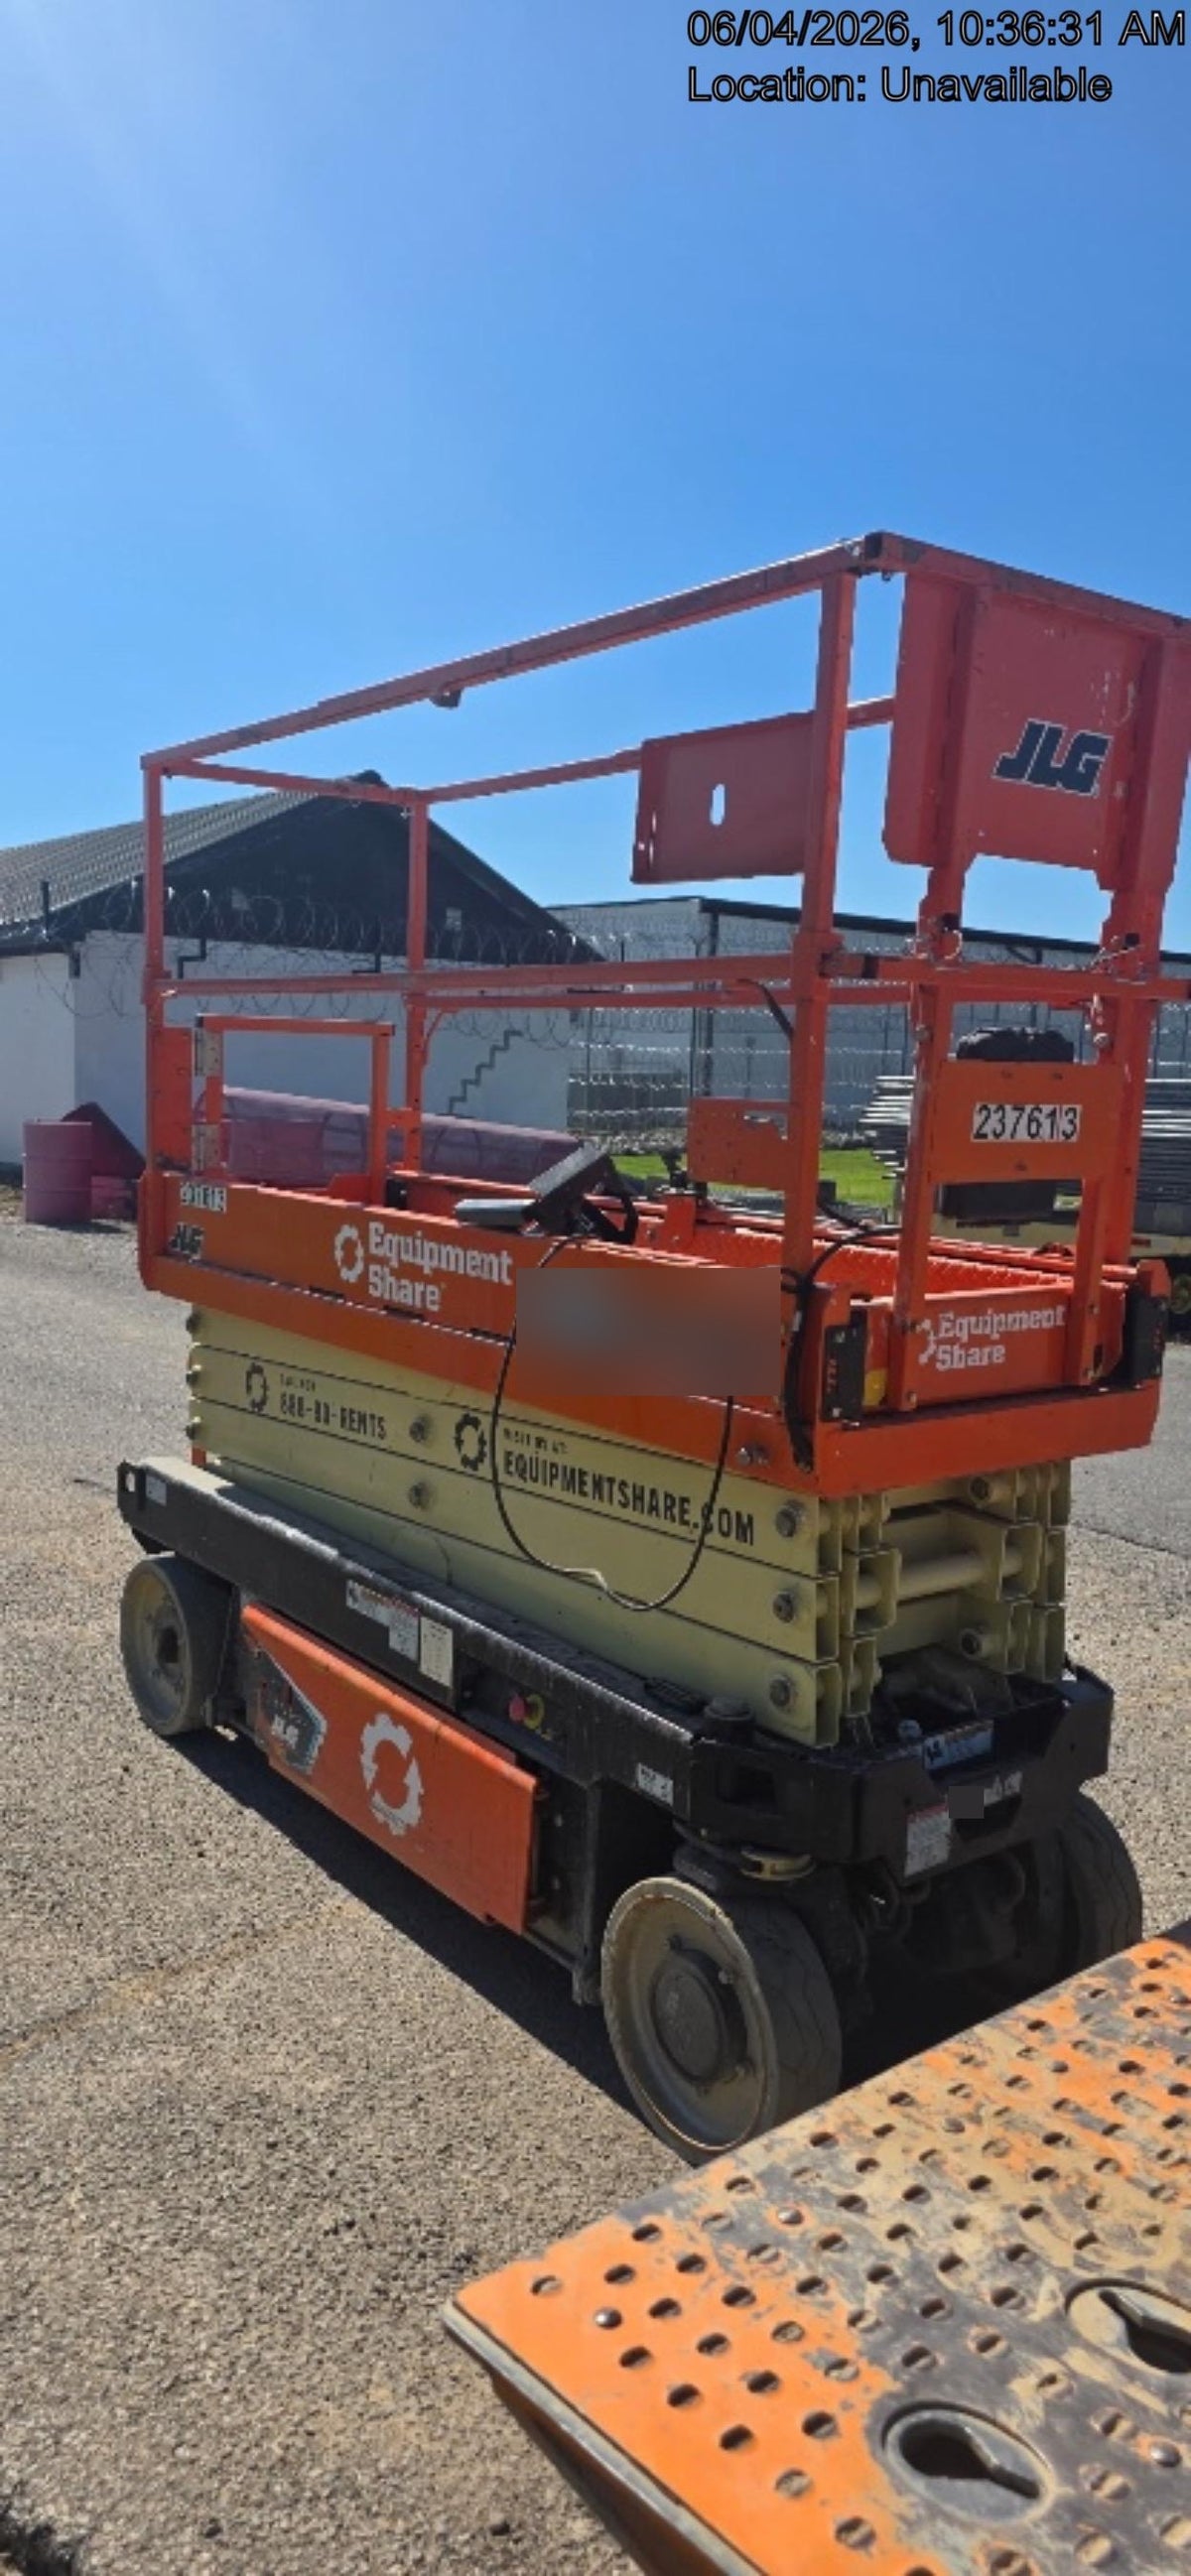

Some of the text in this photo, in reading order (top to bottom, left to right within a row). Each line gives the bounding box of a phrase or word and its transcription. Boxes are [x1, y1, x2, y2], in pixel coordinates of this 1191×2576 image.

[992, 718, 1113, 798] JLG
[973, 1103, 1078, 1140] 237613
[368, 1222, 513, 1286] Equipment
[368, 1263, 441, 1313] Share
[939, 1304, 1066, 1343] Equipment
[936, 1344, 1006, 1372] Share
[503, 1450, 754, 1545] EQUIPMENTSHARE.COM
